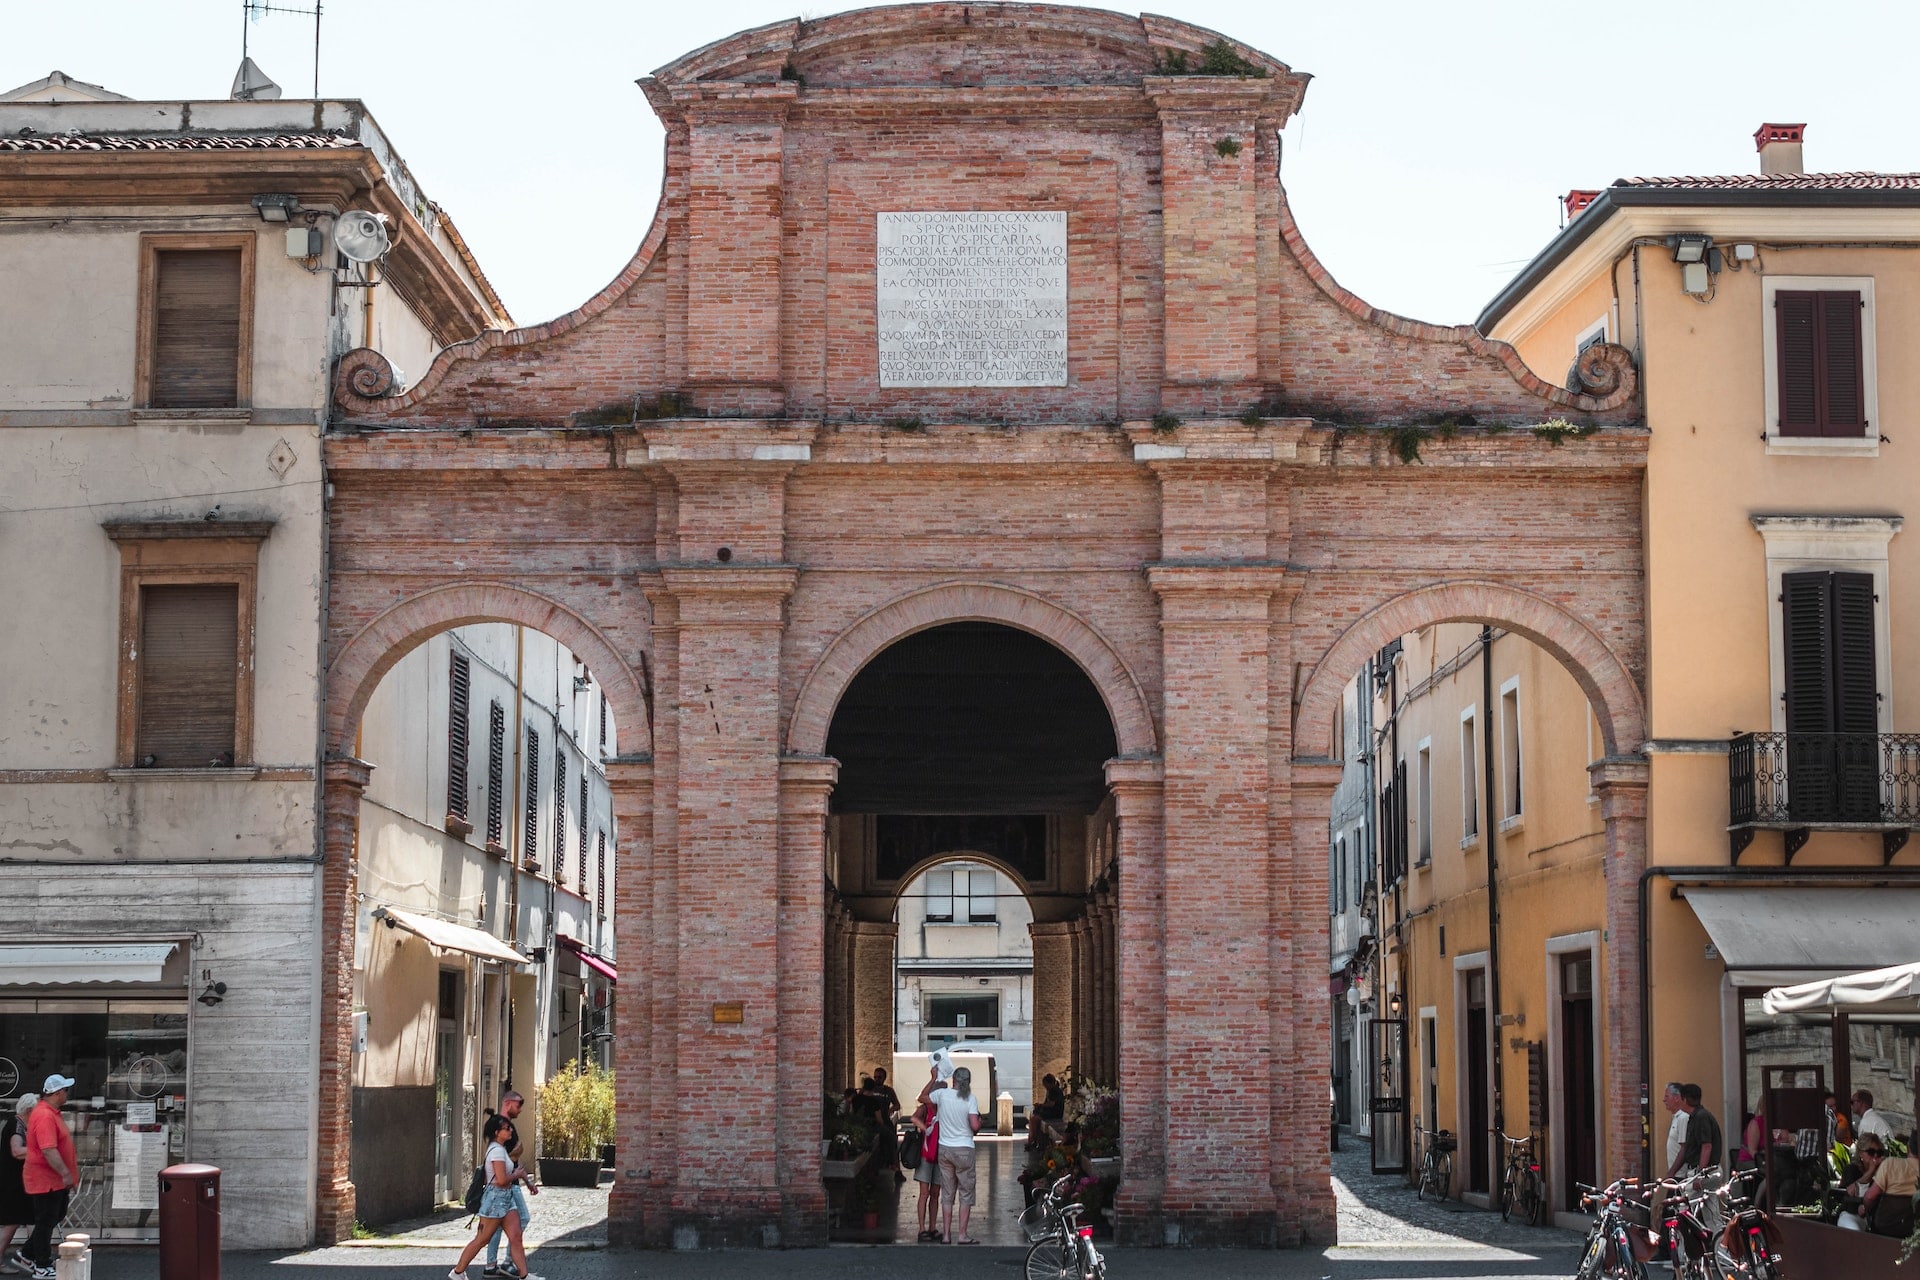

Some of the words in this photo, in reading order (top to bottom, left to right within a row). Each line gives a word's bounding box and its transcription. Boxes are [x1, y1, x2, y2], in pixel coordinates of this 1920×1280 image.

[884, 214, 920, 223] ANNO
[925, 214, 966, 223] DOMINI
[949, 224, 1028, 233] ARIMINENSIS
[902, 235, 968, 245] PORTICVS
[973, 234, 1041, 245] PISCARIAS
[879, 246, 948, 256] PISCATORIAE
[879, 257, 936, 266] COMMODO
[939, 257, 994, 266] INDVLGENS
[1018, 257, 1066, 266] CONLATO
[917, 268, 996, 277] FVNDAMENTIS
[1000, 268, 1039, 276] EREXIT
[883, 279, 896, 287] EA
[900, 278, 973, 287] CONDITIONE
[919, 289, 946, 298] CVM
[951, 288, 1026, 298] PARTICIPIBVS
[904, 300, 938, 309] PISCIS
[898, 310, 928, 319] NAVIS
[1027, 310, 1063, 318] LXXX
[918, 320, 979, 330] QVOTANNIS
[984, 320, 1025, 329] SOLVAT
[880, 331, 926, 342] QVORVM
[929, 331, 954, 340] PARS
[903, 341, 937, 352] QVOD
[941, 341, 979, 350] ANTEA
[981, 341, 1046, 349] EXIGEBATVR
[881, 351, 935, 362] RELIQVVM
[940, 351, 949, 360] IN
[954, 351, 988, 360] DEBITI
[881, 362, 904, 372] QVO
[907, 362, 948, 370] SOLVTO
[884, 372, 934, 381] AERARIO
[938, 372, 983, 380] PVBLICO
[202, 969, 211, 980] 11
